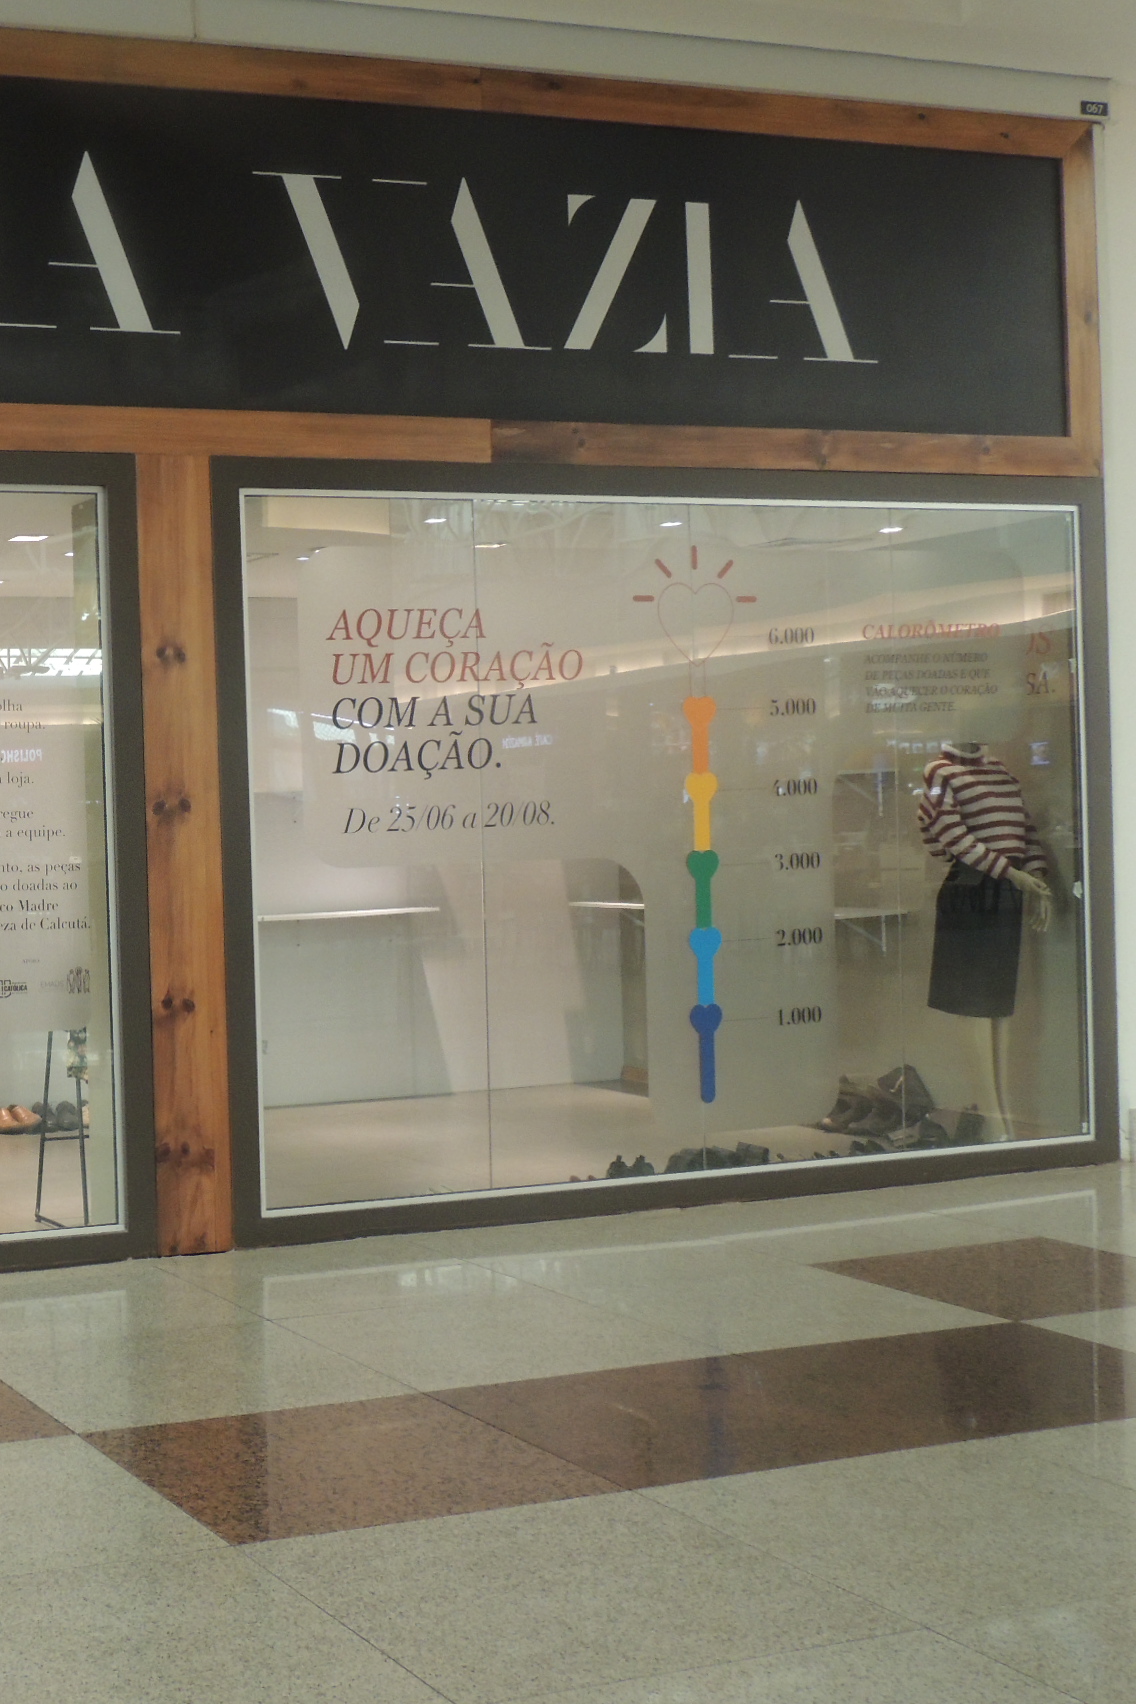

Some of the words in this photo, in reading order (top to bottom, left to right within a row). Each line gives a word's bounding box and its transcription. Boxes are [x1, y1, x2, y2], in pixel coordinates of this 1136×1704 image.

[1086, 103, 1104, 114] 067
[252, 171, 878, 364] VAZIA
[325, 608, 487, 648] AQUEÇA
[768, 626, 815, 645] 6.000
[332, 652, 394, 685] UM
[405, 642, 583, 689] CORAÇÃO
[331, 696, 421, 730] COM
[427, 695, 454, 727] A
[464, 693, 538, 726] SUA
[769, 698, 816, 716] 5.000
[332, 730, 502, 780] DOAÇÃO.
[7, 771, 34, 788] loja.
[773, 778, 818, 796] 4.000
[344, 807, 380, 834] De
[386, 804, 456, 833] 25/06
[462, 812, 477, 829] a
[484, 800, 555, 828] 20/08.
[5, 829, 12, 838] a
[17, 825, 66, 841] equipe.
[27, 863, 40, 872] as
[45, 862, 81, 876] peças
[775, 852, 821, 870] 3.000
[12, 879, 59, 892] doadas
[62, 881, 78, 891] ao
[18, 899, 59, 912] Madre
[20, 918, 36, 931] de
[40, 916, 91, 930] Calcutá.
[775, 927, 823, 946] 2.000
[778, 1006, 822, 1025] 1.000
